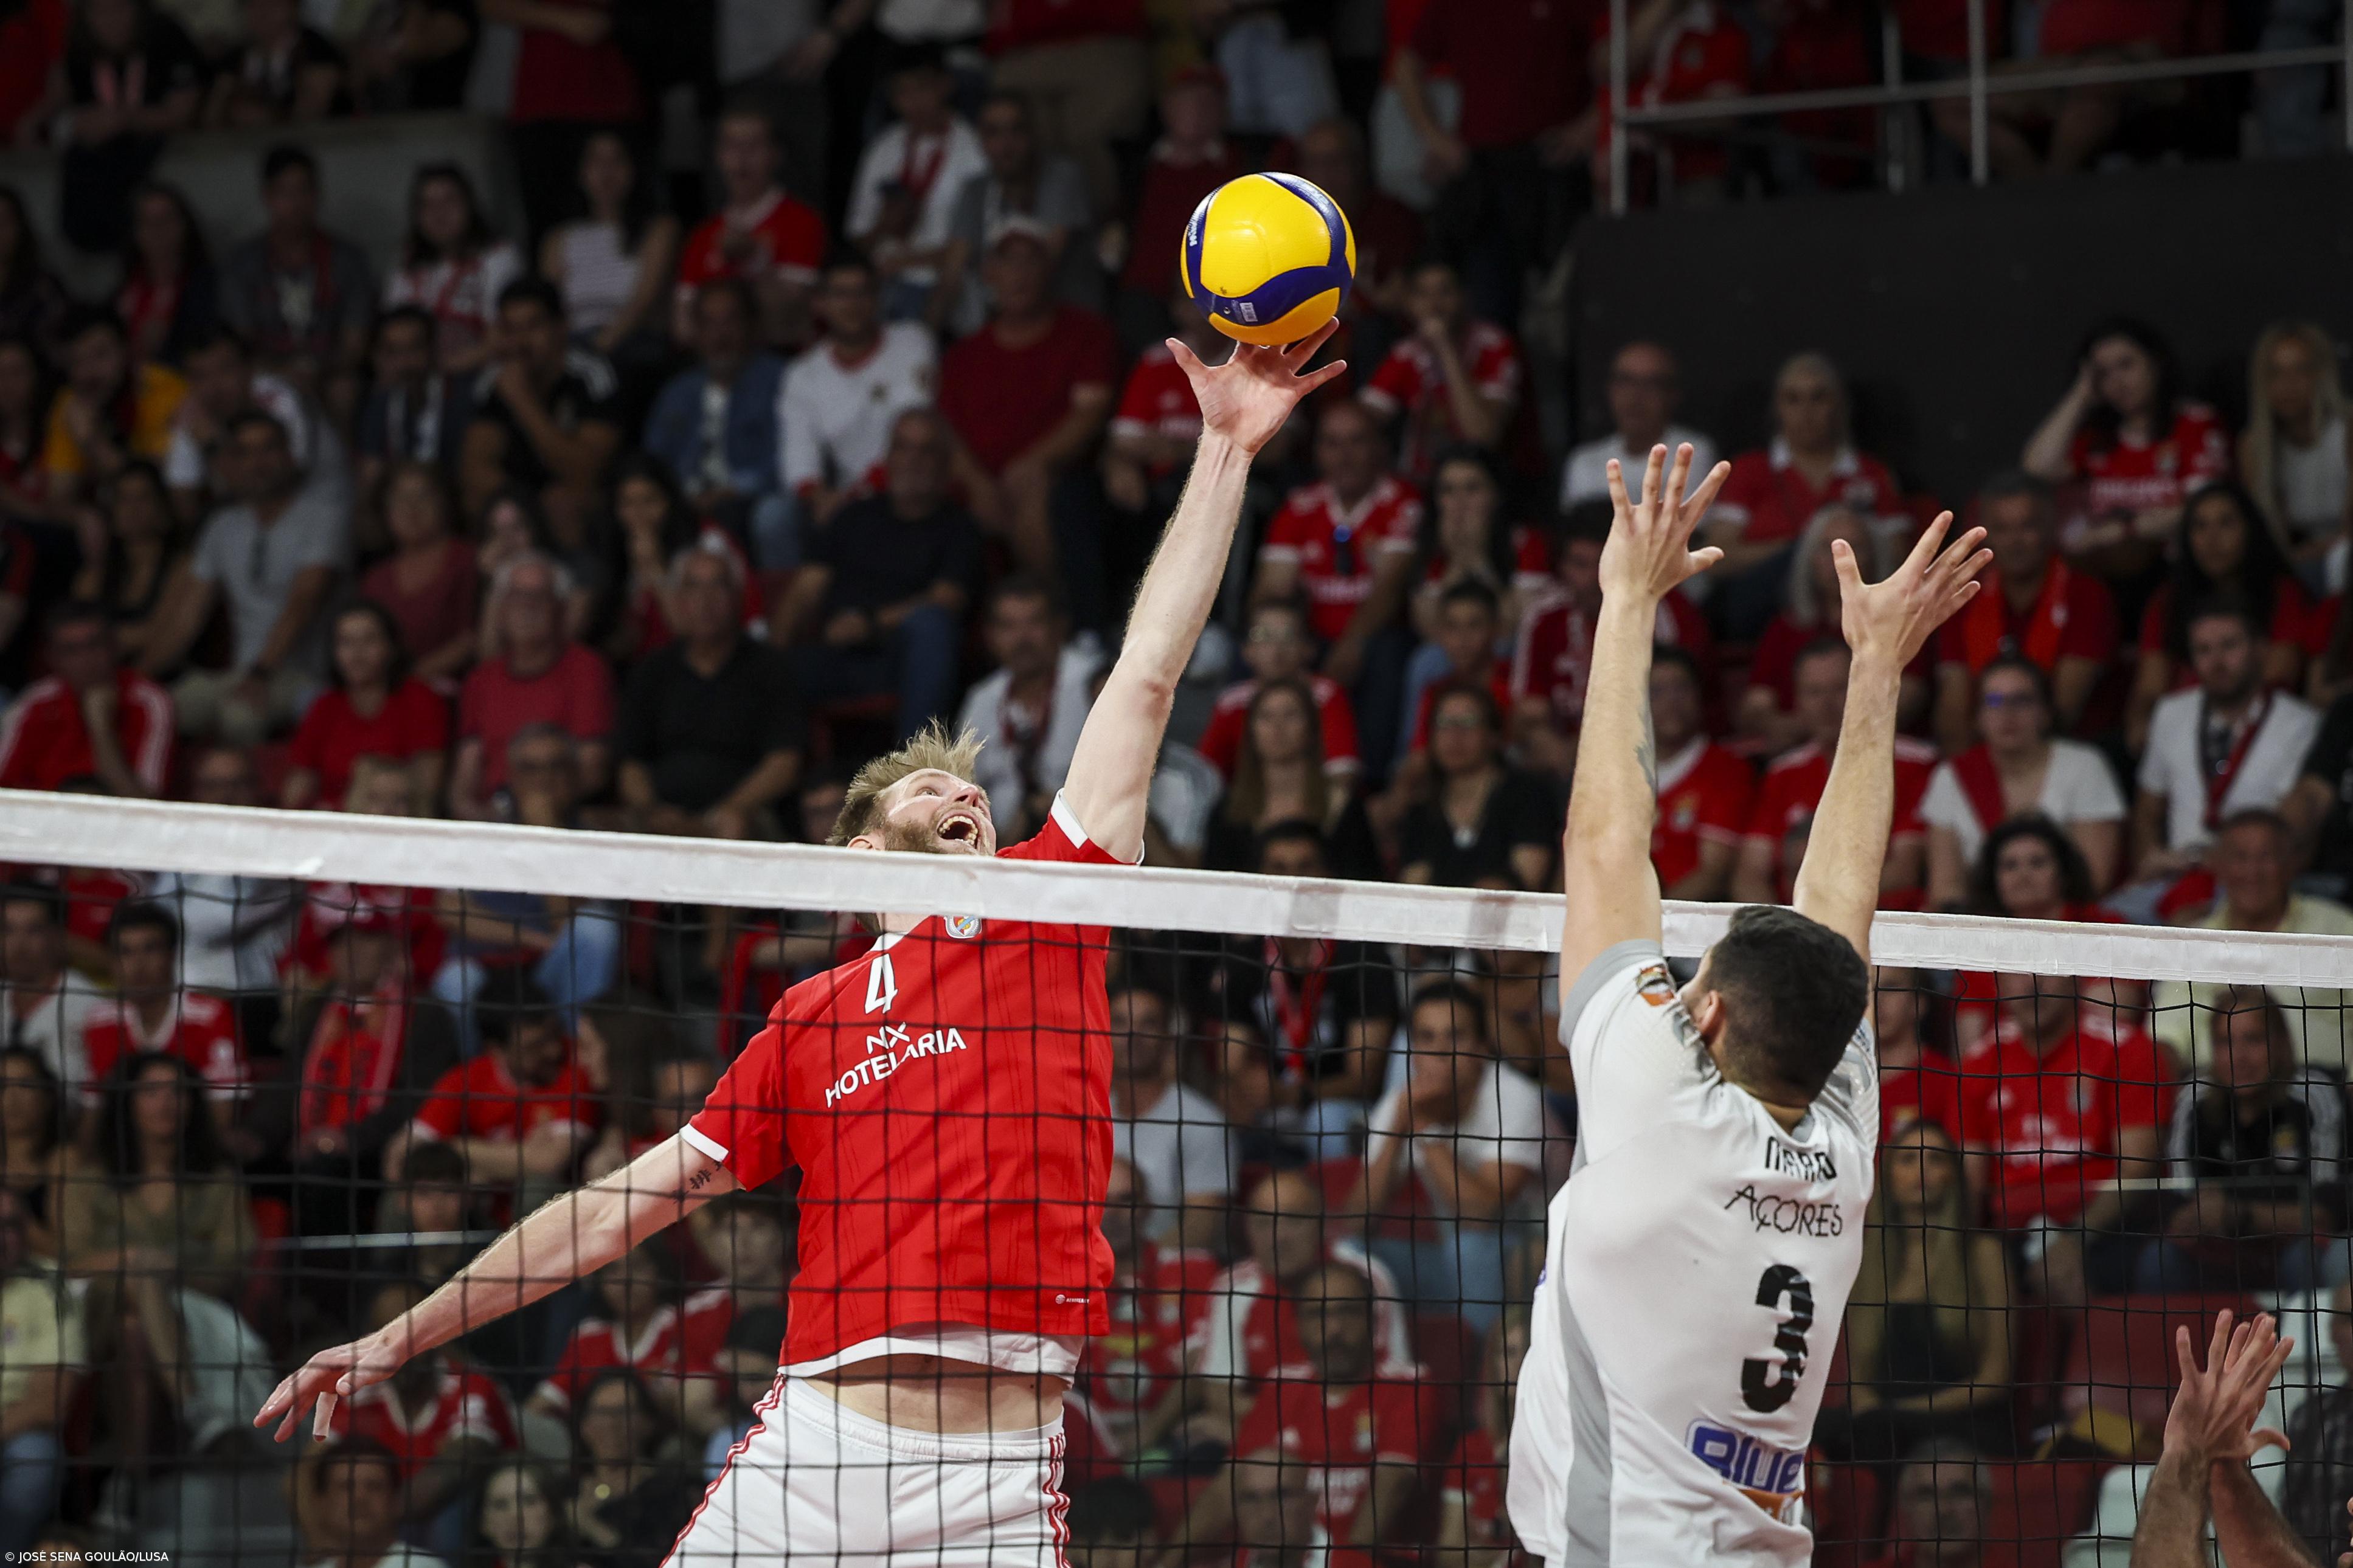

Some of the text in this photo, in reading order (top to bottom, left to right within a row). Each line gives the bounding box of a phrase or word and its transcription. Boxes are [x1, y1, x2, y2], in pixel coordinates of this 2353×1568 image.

[864, 953, 898, 1014] 4
[825, 1027, 967, 1108] HOTELARIA
[866, 1021, 910, 1054] NX
[1724, 1184, 1843, 1237] AÇORES
[1741, 1264, 1814, 1413] 3
